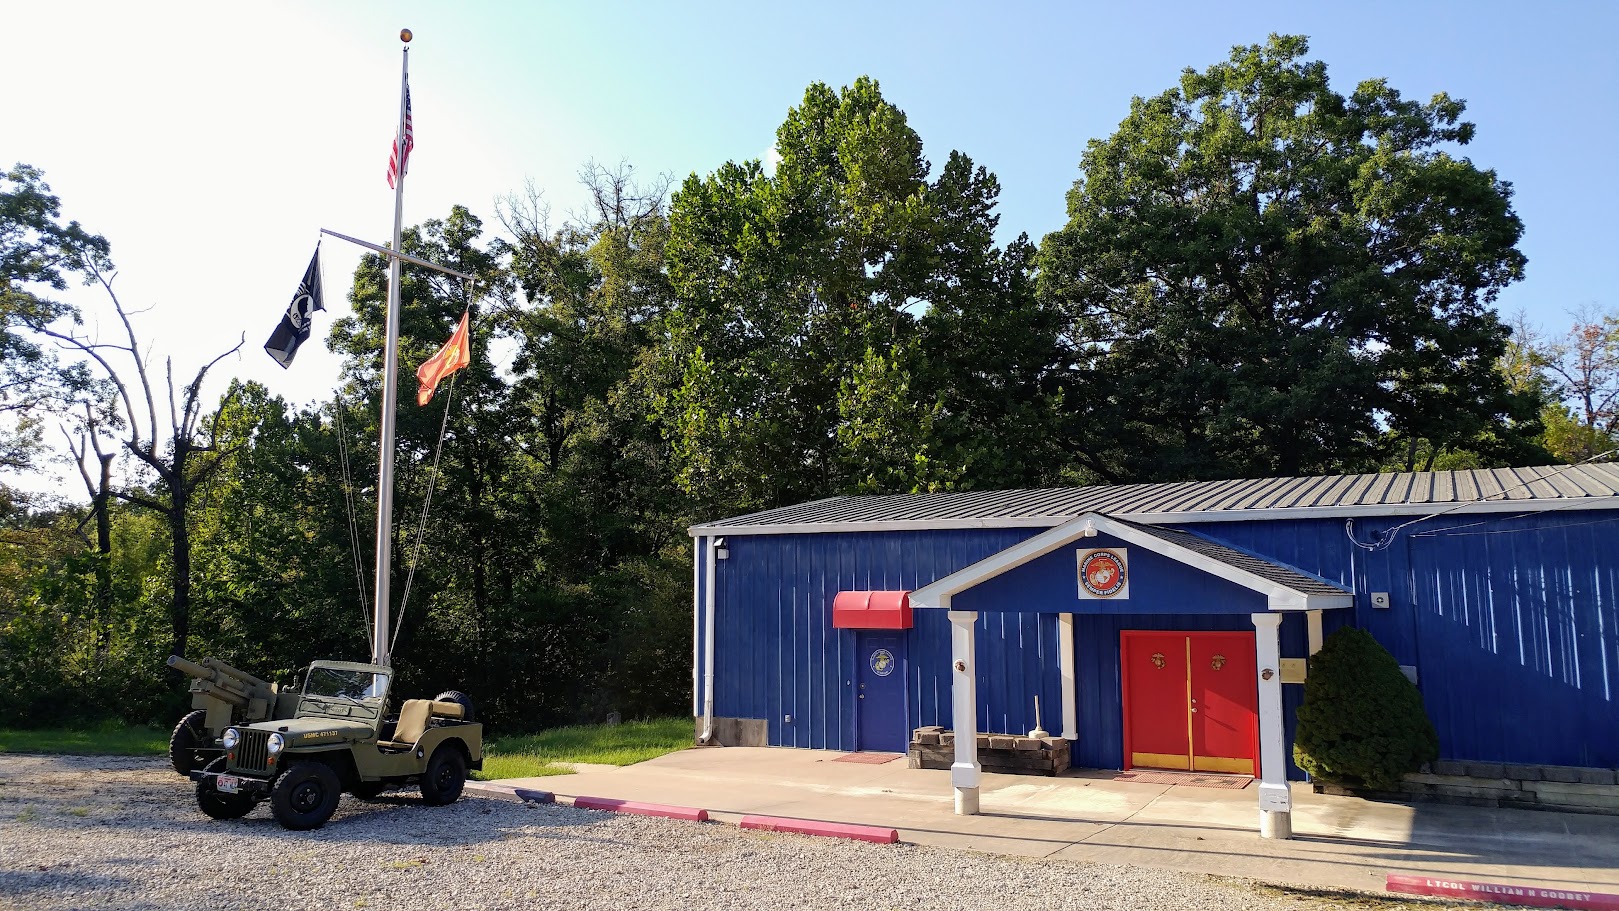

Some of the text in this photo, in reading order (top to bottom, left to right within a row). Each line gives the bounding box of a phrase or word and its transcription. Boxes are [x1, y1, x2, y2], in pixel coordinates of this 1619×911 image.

[1082, 556, 1093, 572] MARINE
[1111, 555, 1124, 572] LEAGUE
[1085, 582, 1103, 595] SEMPER
[1426, 879, 1466, 890] LTCOL
[1471, 884, 1524, 896] WILLIAM
